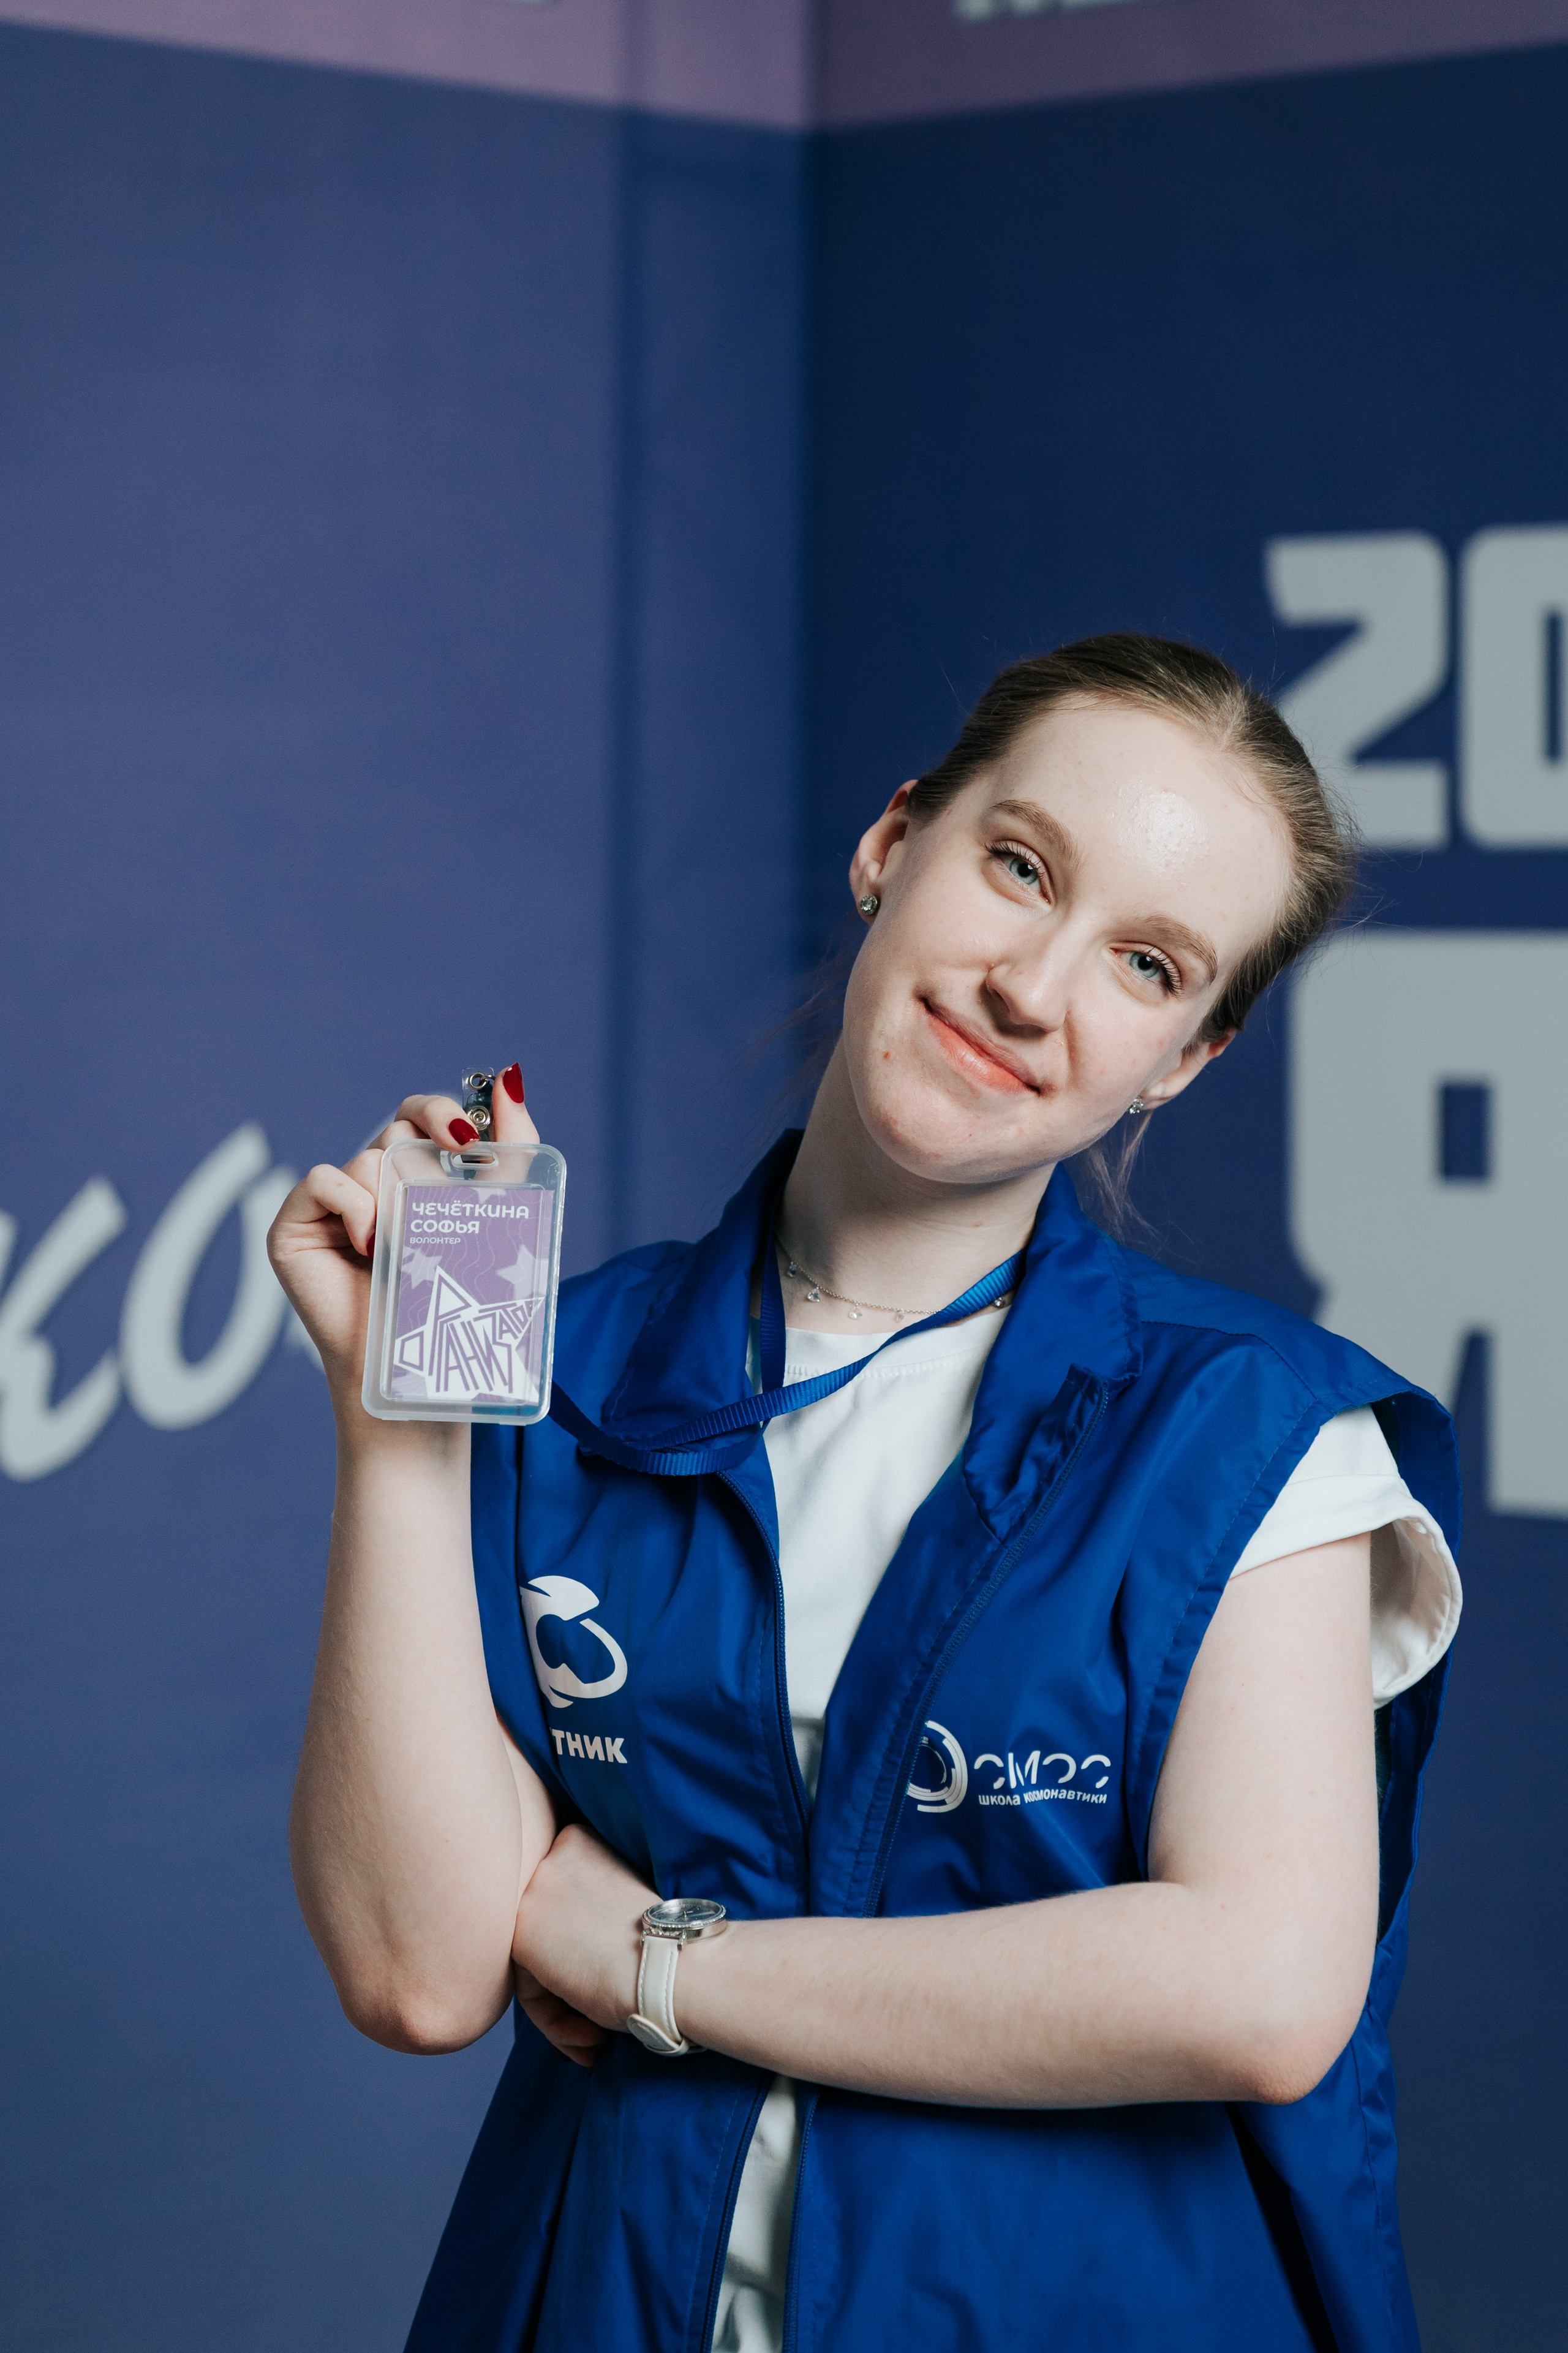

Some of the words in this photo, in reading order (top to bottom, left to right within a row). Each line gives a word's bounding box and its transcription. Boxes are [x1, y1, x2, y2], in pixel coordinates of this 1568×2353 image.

[412, 1200, 529, 1219] ЧЕЧЁТКИНА
[410, 1219, 480, 1234] СОФЬЯ
[399, 1273, 535, 1394] ОРГАНИЗАТОР
[550, 1728, 628, 1764] ТНИК
[979, 1794, 1020, 1805] школа
[1023, 1789, 1107, 1803] космонавтики
